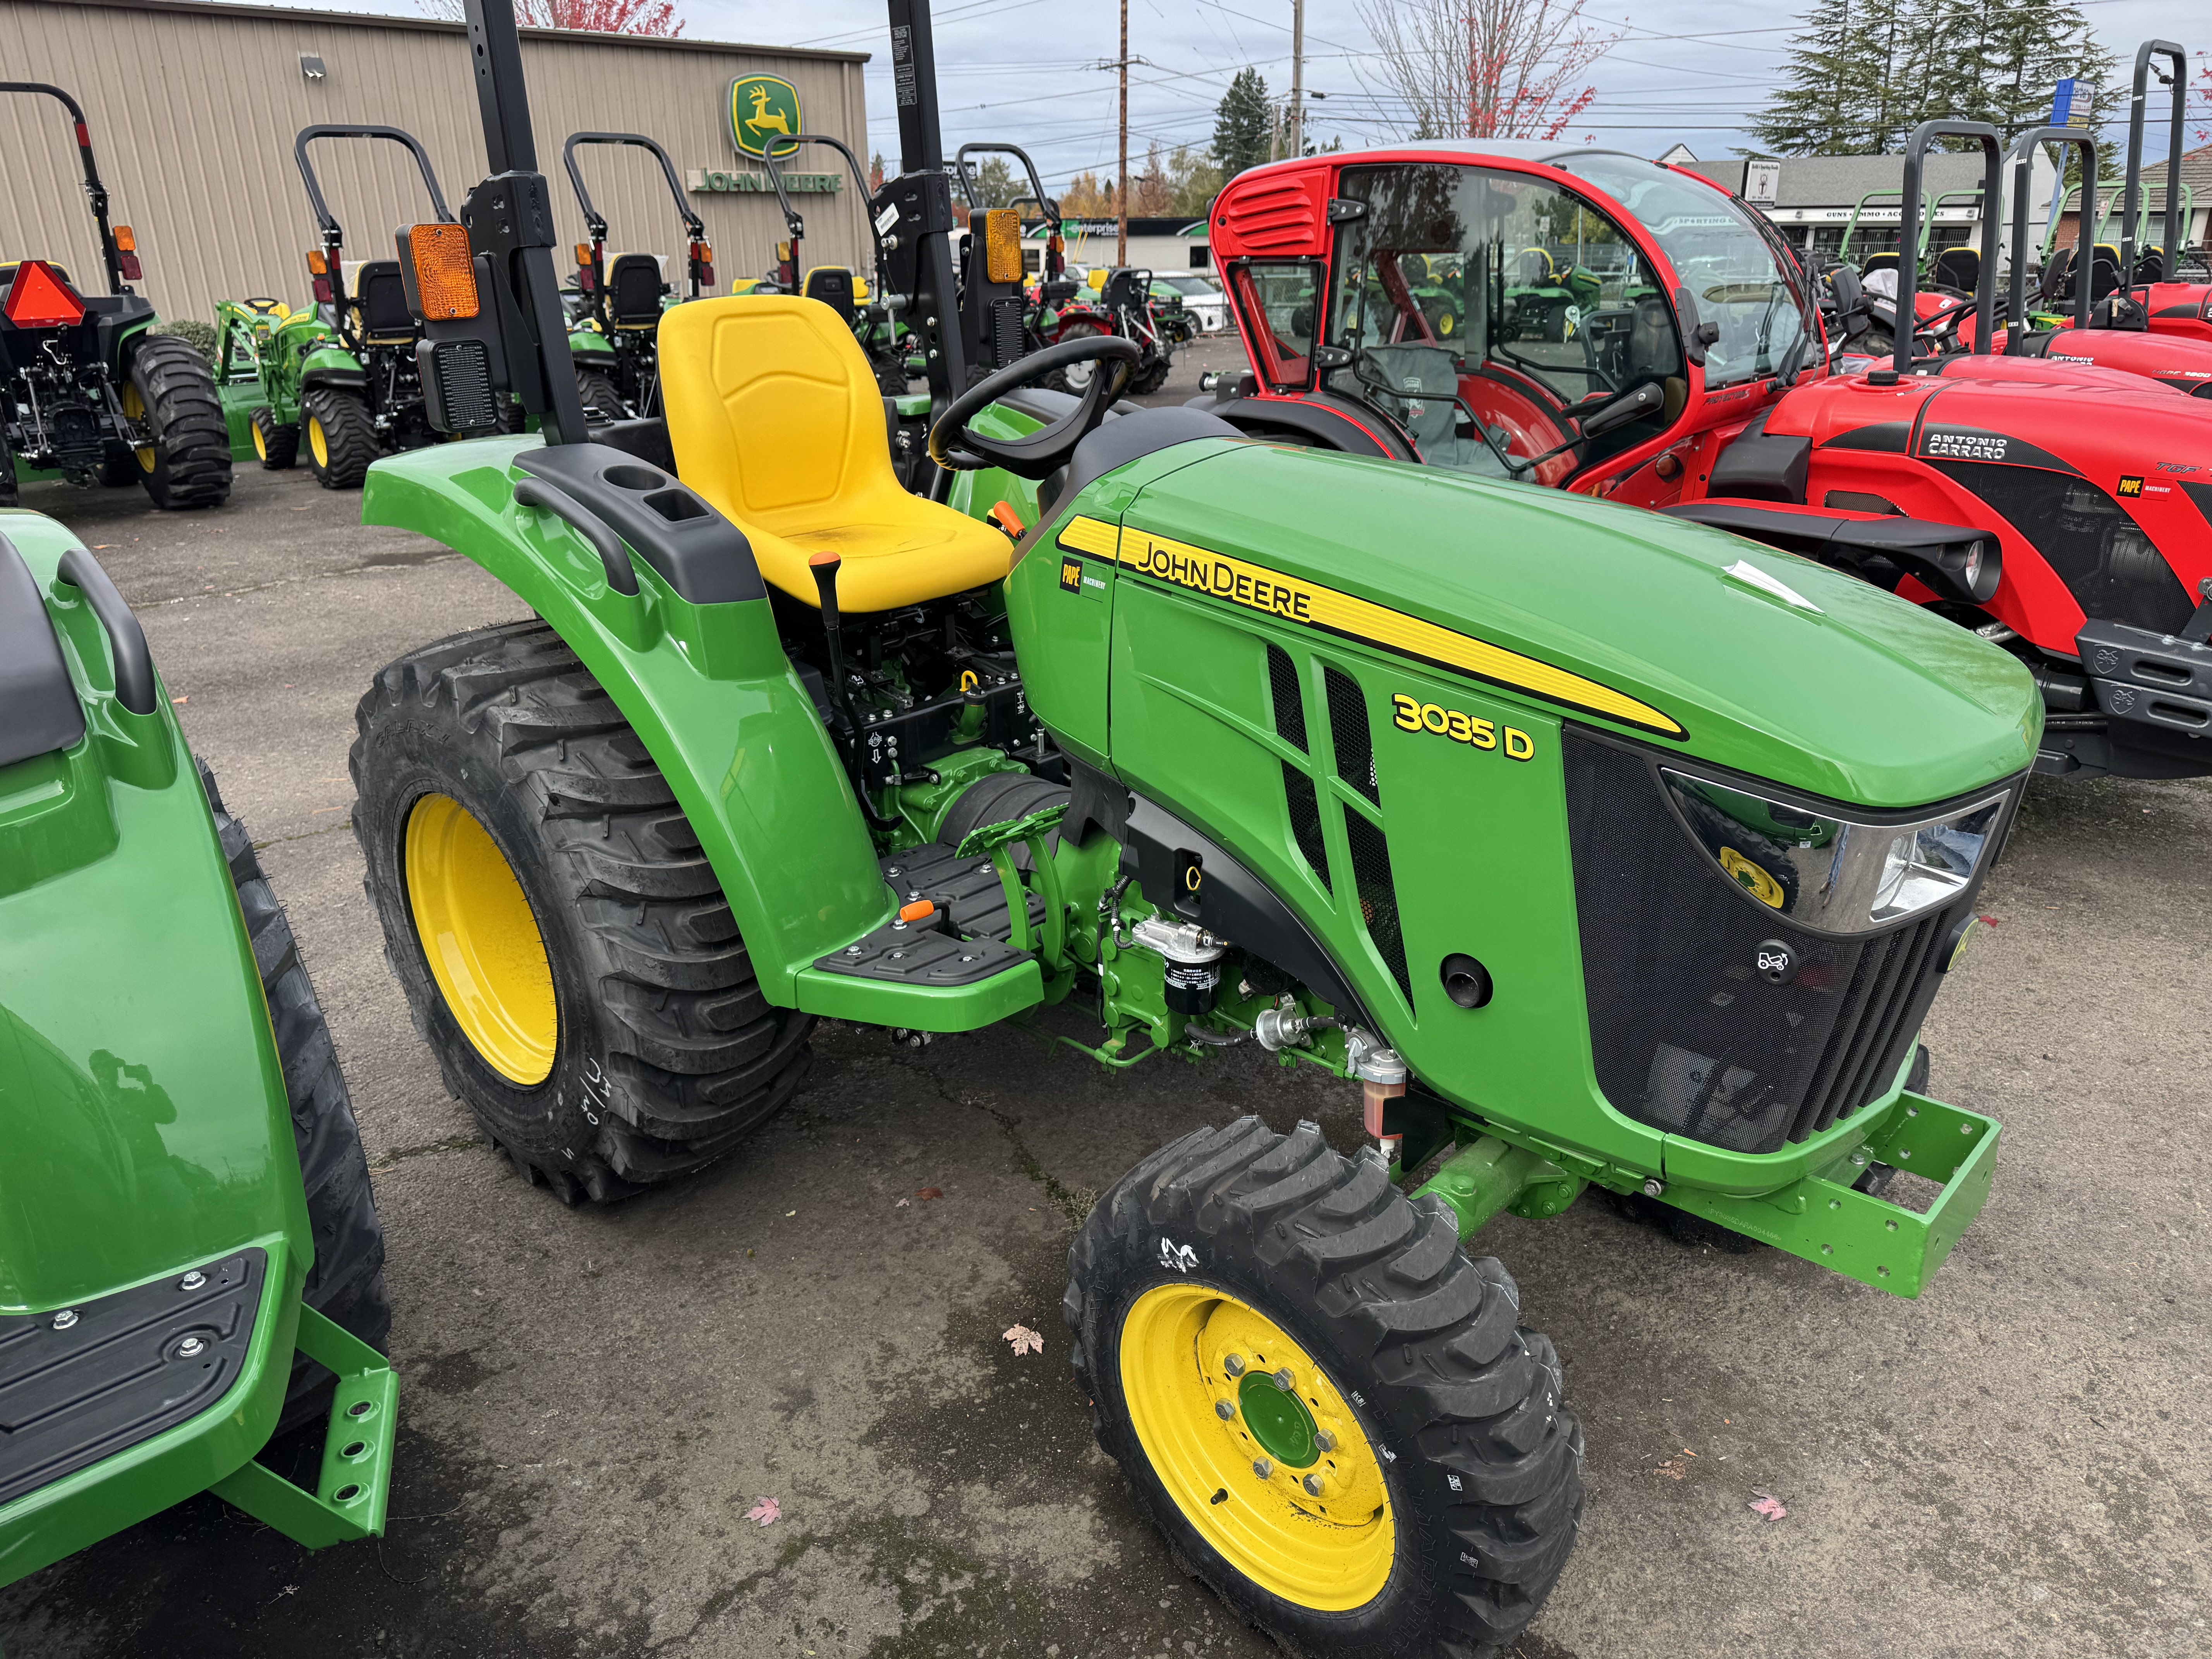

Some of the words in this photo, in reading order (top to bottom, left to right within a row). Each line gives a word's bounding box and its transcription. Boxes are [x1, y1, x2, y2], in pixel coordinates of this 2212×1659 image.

[696, 168, 762, 192] JOHN
[1930, 434, 2008, 447] ANTONIO
[1928, 442, 2006, 459] CARRARO
[2155, 462, 2202, 474] TGF
[2145, 485, 2171, 493] MACHINERY
[1083, 576, 1106, 590] MACHINERY
[1138, 541, 1208, 587] JOHN
[1214, 561, 1311, 619] DEERE
[1392, 693, 1497, 751] 3035
[1502, 725, 1535, 763] D
